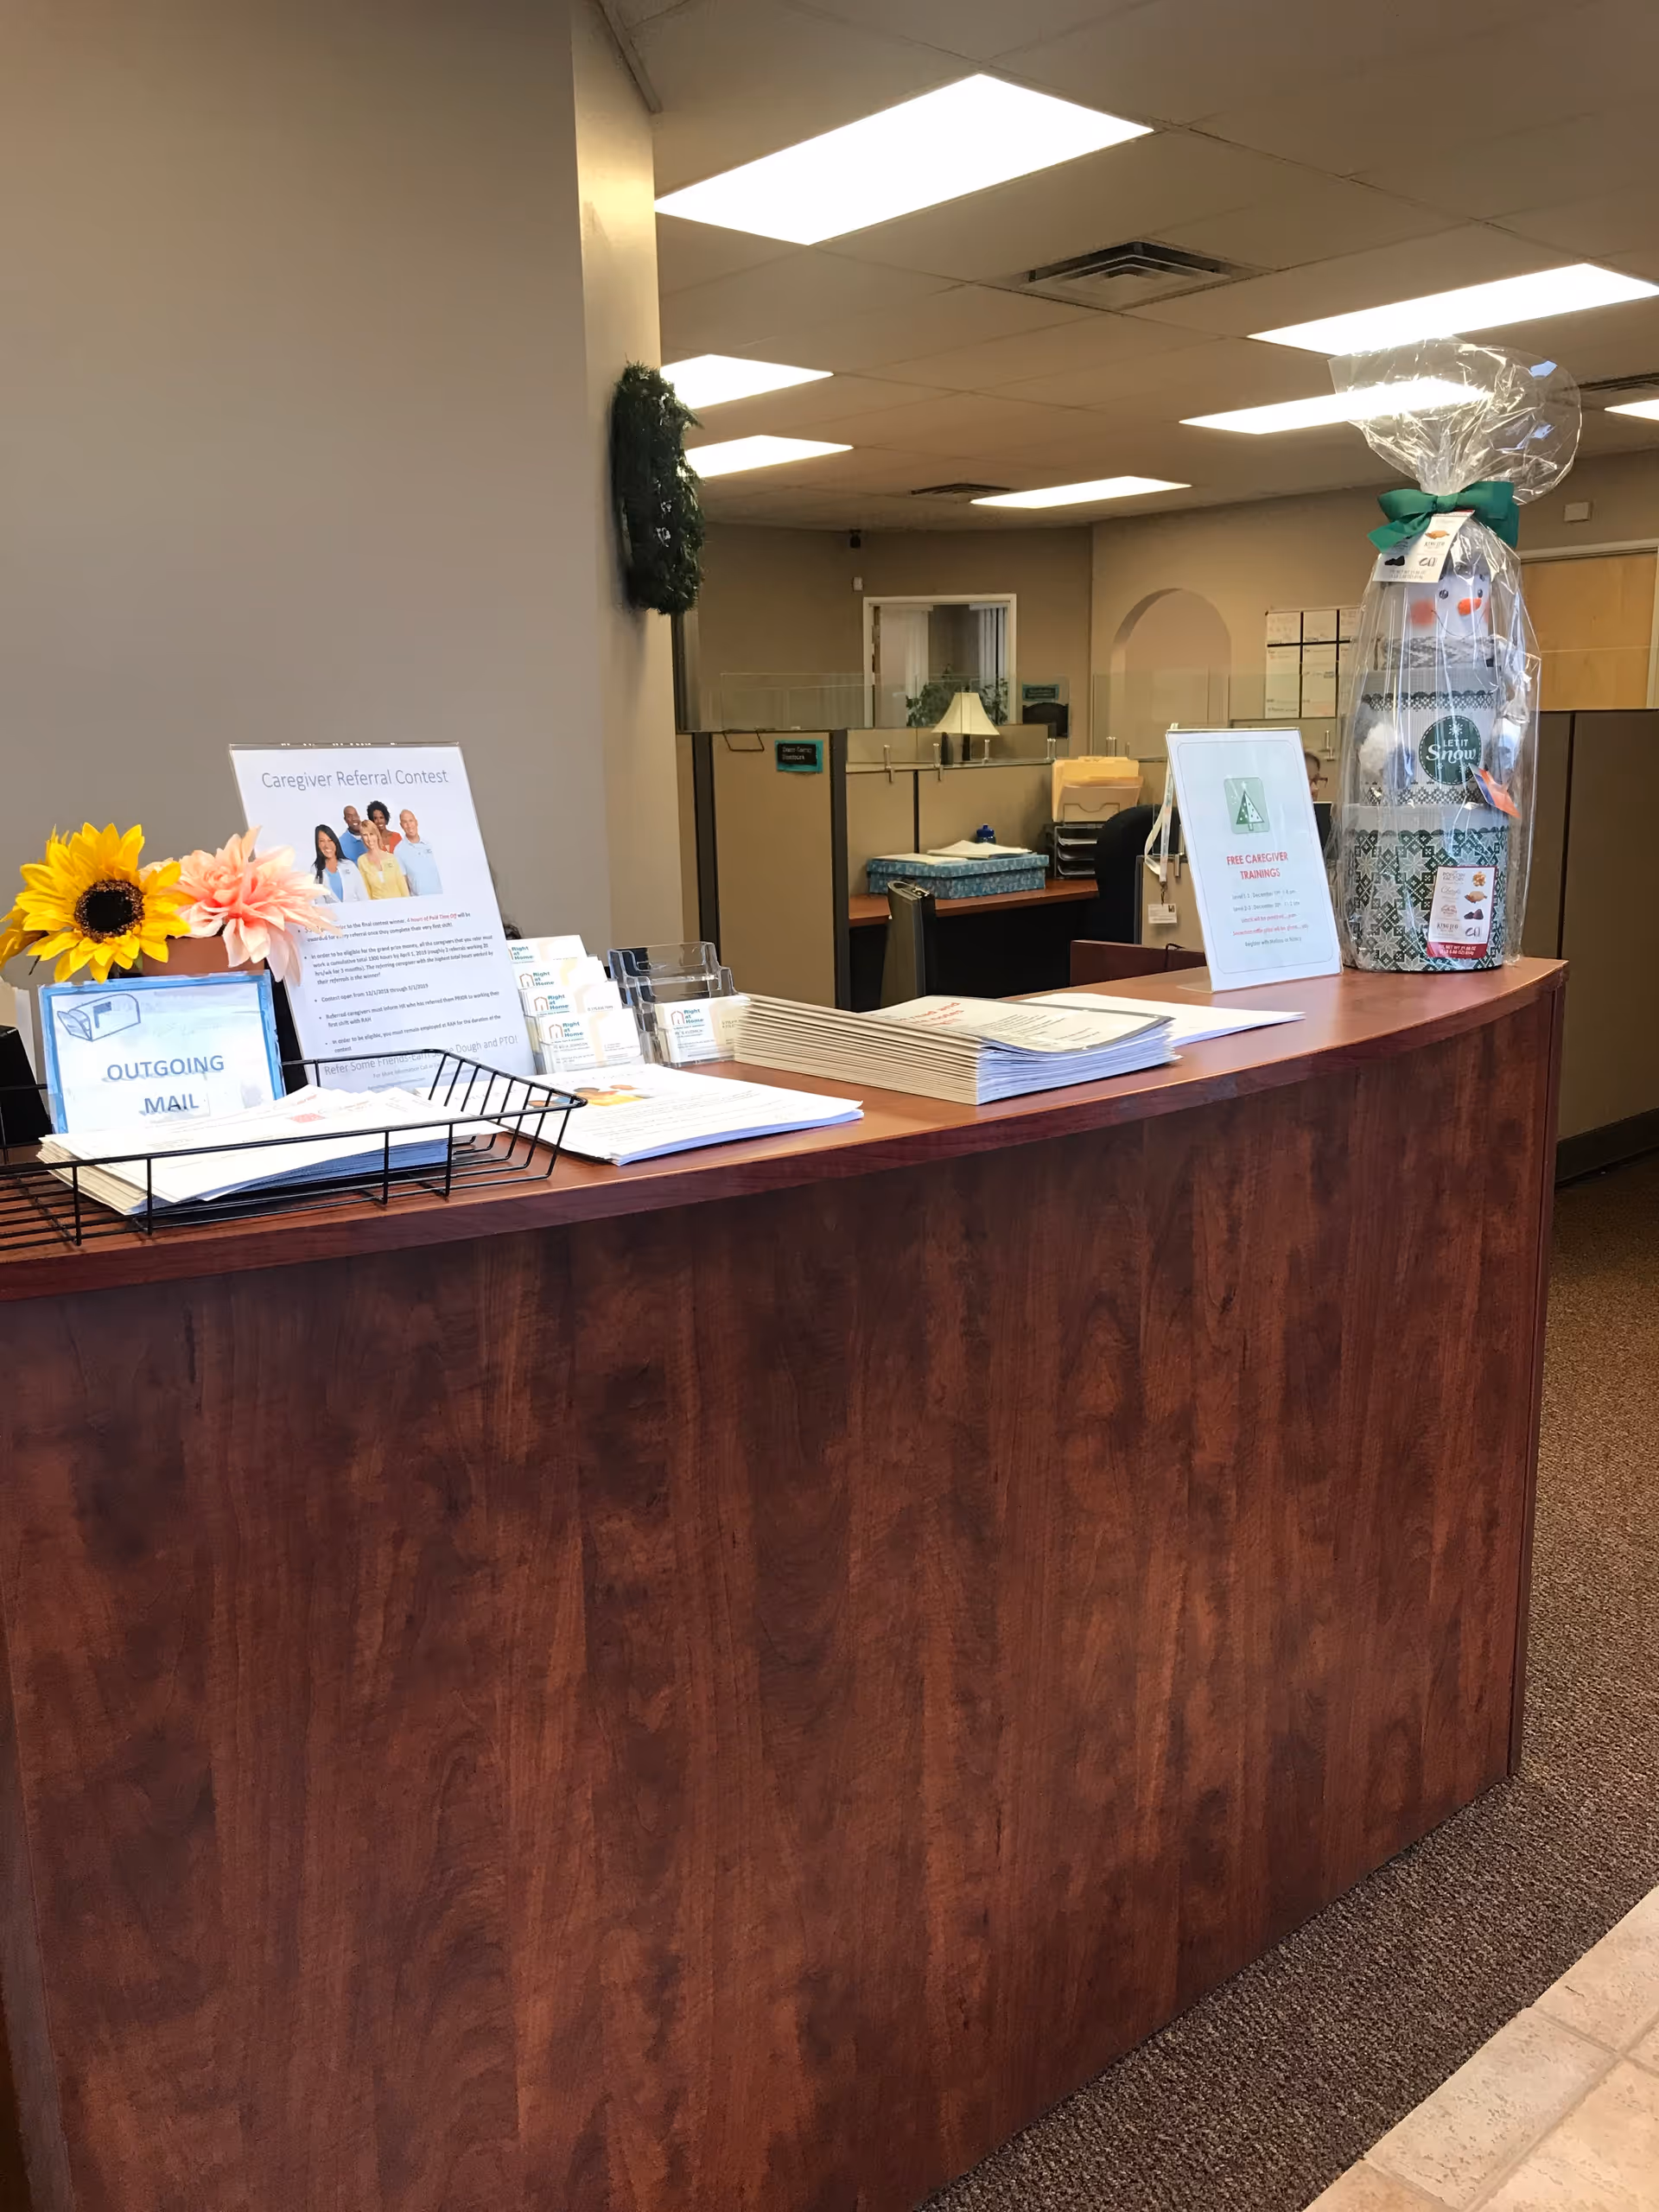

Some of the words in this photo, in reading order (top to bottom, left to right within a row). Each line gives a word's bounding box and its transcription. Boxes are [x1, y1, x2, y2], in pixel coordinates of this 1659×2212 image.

[1426, 744, 1476, 763] Snow
[261, 772, 333, 791] Caregiver
[336, 770, 391, 785] Referral
[396, 769, 448, 785] Contest
[1226, 855, 1244, 866] FREE
[1245, 852, 1288, 864] CAREGIVER
[1240, 868, 1281, 880] TRAININGS
[324, 1065, 348, 1076] Refer
[351, 1059, 376, 1071] Some
[455, 1042, 482, 1052] Dough
[484, 1039, 498, 1049] and
[499, 1035, 518, 1044] PTO!
[106, 1055, 225, 1081] OUTGOING
[144, 1093, 200, 1114] MAIL
